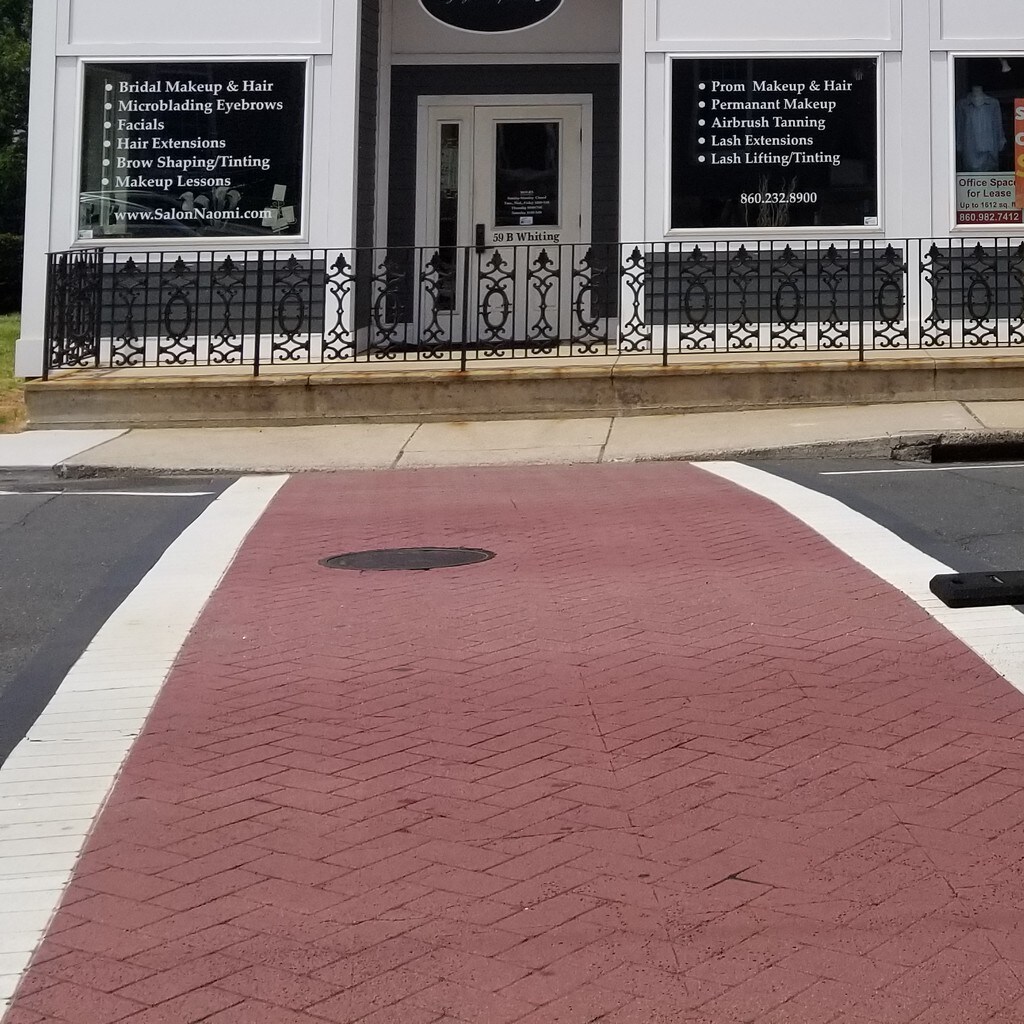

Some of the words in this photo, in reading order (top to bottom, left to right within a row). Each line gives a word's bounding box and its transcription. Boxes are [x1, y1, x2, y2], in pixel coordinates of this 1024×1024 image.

[119, 81, 161, 93] Bridal
[165, 81, 222, 96] Makeup
[226, 81, 239, 92] &
[242, 80, 274, 92] Hair
[711, 81, 746, 92] Prom
[752, 80, 805, 95] Makeup
[809, 81, 820, 91] &
[824, 80, 853, 91] Hair
[118, 99, 213, 114] Microblading
[216, 99, 283, 112] Eyebrows
[711, 99, 780, 110] Permanant
[783, 98, 836, 113] Makeup
[117, 118, 164, 131] Facials
[711, 117, 769, 128] Airbrush
[773, 116, 826, 130] Tanning
[117, 137, 148, 149] Hair
[152, 137, 226, 149] Extensions
[711, 135, 741, 146] Lash
[745, 134, 813, 146] Extensions
[116, 157, 153, 168] Brow
[157, 155, 270, 171] Shaping/Tinting
[711, 153, 741, 164] Lash
[745, 152, 841, 166] Lifting/Tinting
[115, 176, 173, 191] Makeup
[177, 175, 231, 187] Lessons
[959, 178, 987, 186] Office
[740, 192, 817, 204] 860.232.8900
[967, 189, 981, 197] for
[115, 207, 272, 221] www.SalonNaomi.com
[959, 213, 1019, 221] 860.982.7412
[493, 233, 504, 242] 59
[506, 233, 513, 241] B
[516, 232, 560, 243] Whiting
